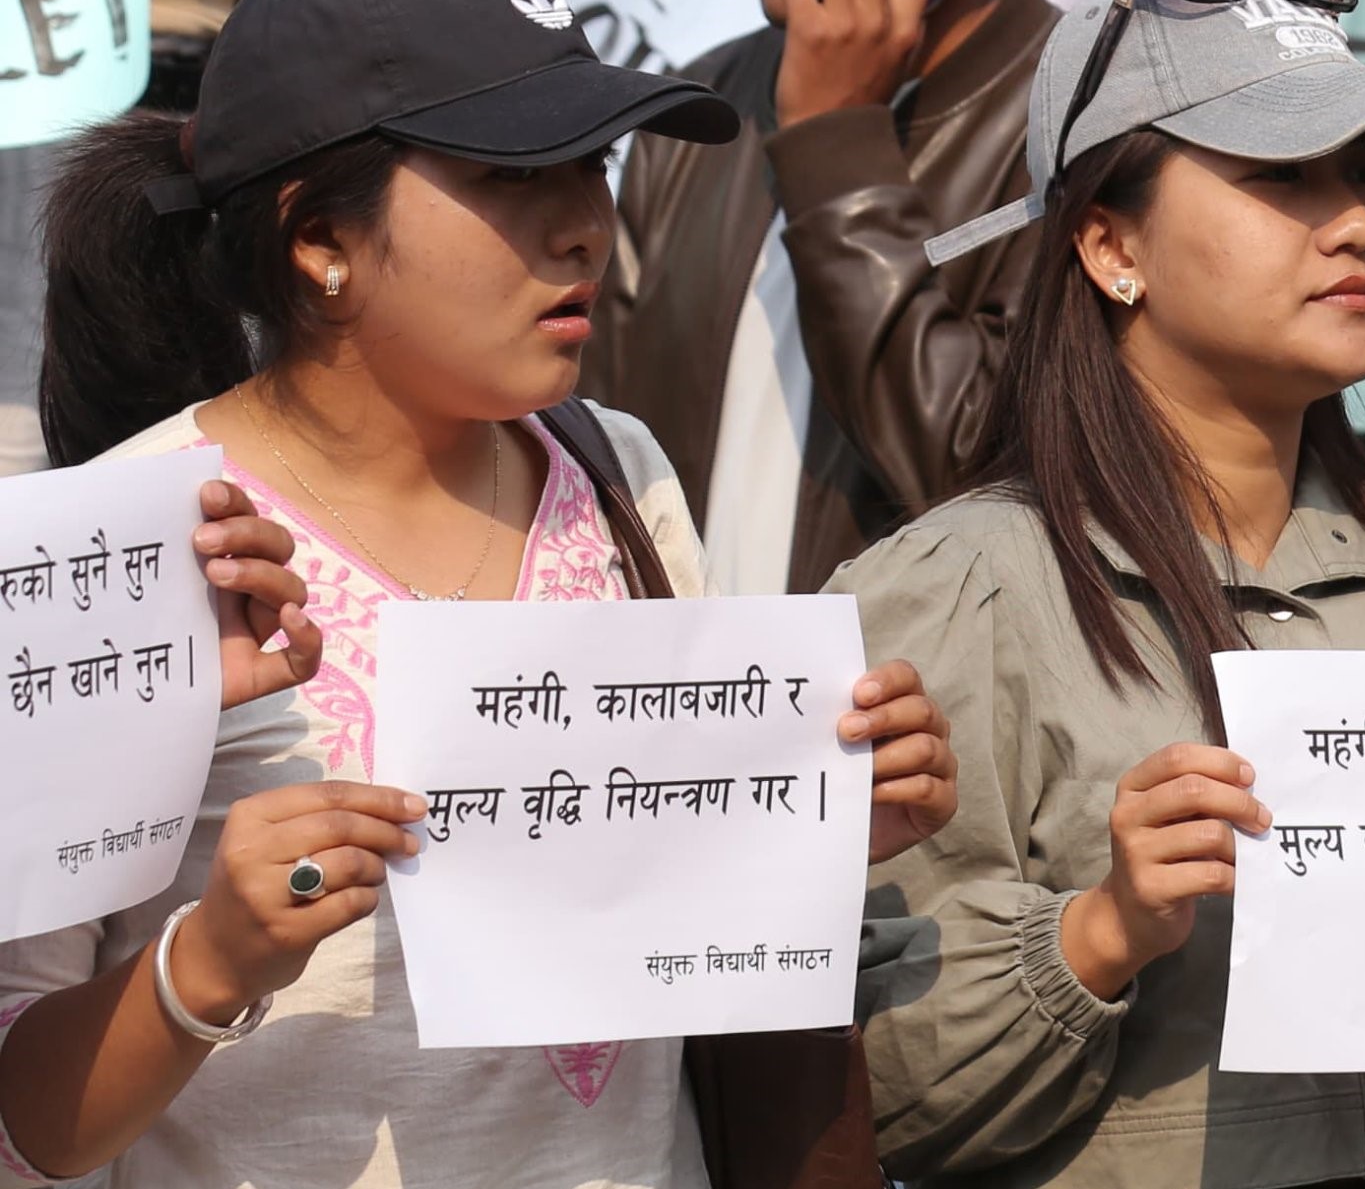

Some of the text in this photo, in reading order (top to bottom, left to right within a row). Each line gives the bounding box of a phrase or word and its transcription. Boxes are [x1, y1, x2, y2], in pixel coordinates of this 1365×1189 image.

[68, 529, 111, 611] सुनै
[122, 542, 163, 601] सुन
[8, 647, 56, 717] छैन
[68, 639, 122, 697] खाने
[133, 643, 173, 702] नुन
[594, 669, 769, 722] कालाबजारी
[785, 678, 809, 716] र
[425, 788, 506, 840] मुल्य
[521, 770, 590, 839] वृद्धि
[605, 767, 735, 815] नियन्त्रण
[749, 776, 798, 813] गर
[57, 816, 184, 874] संयुक्त विद्यार्थी संगठन
[1273, 826, 1345, 876] मुल्य
[645, 944, 832, 984] संयुक्त विद्यार्थी संगठन
